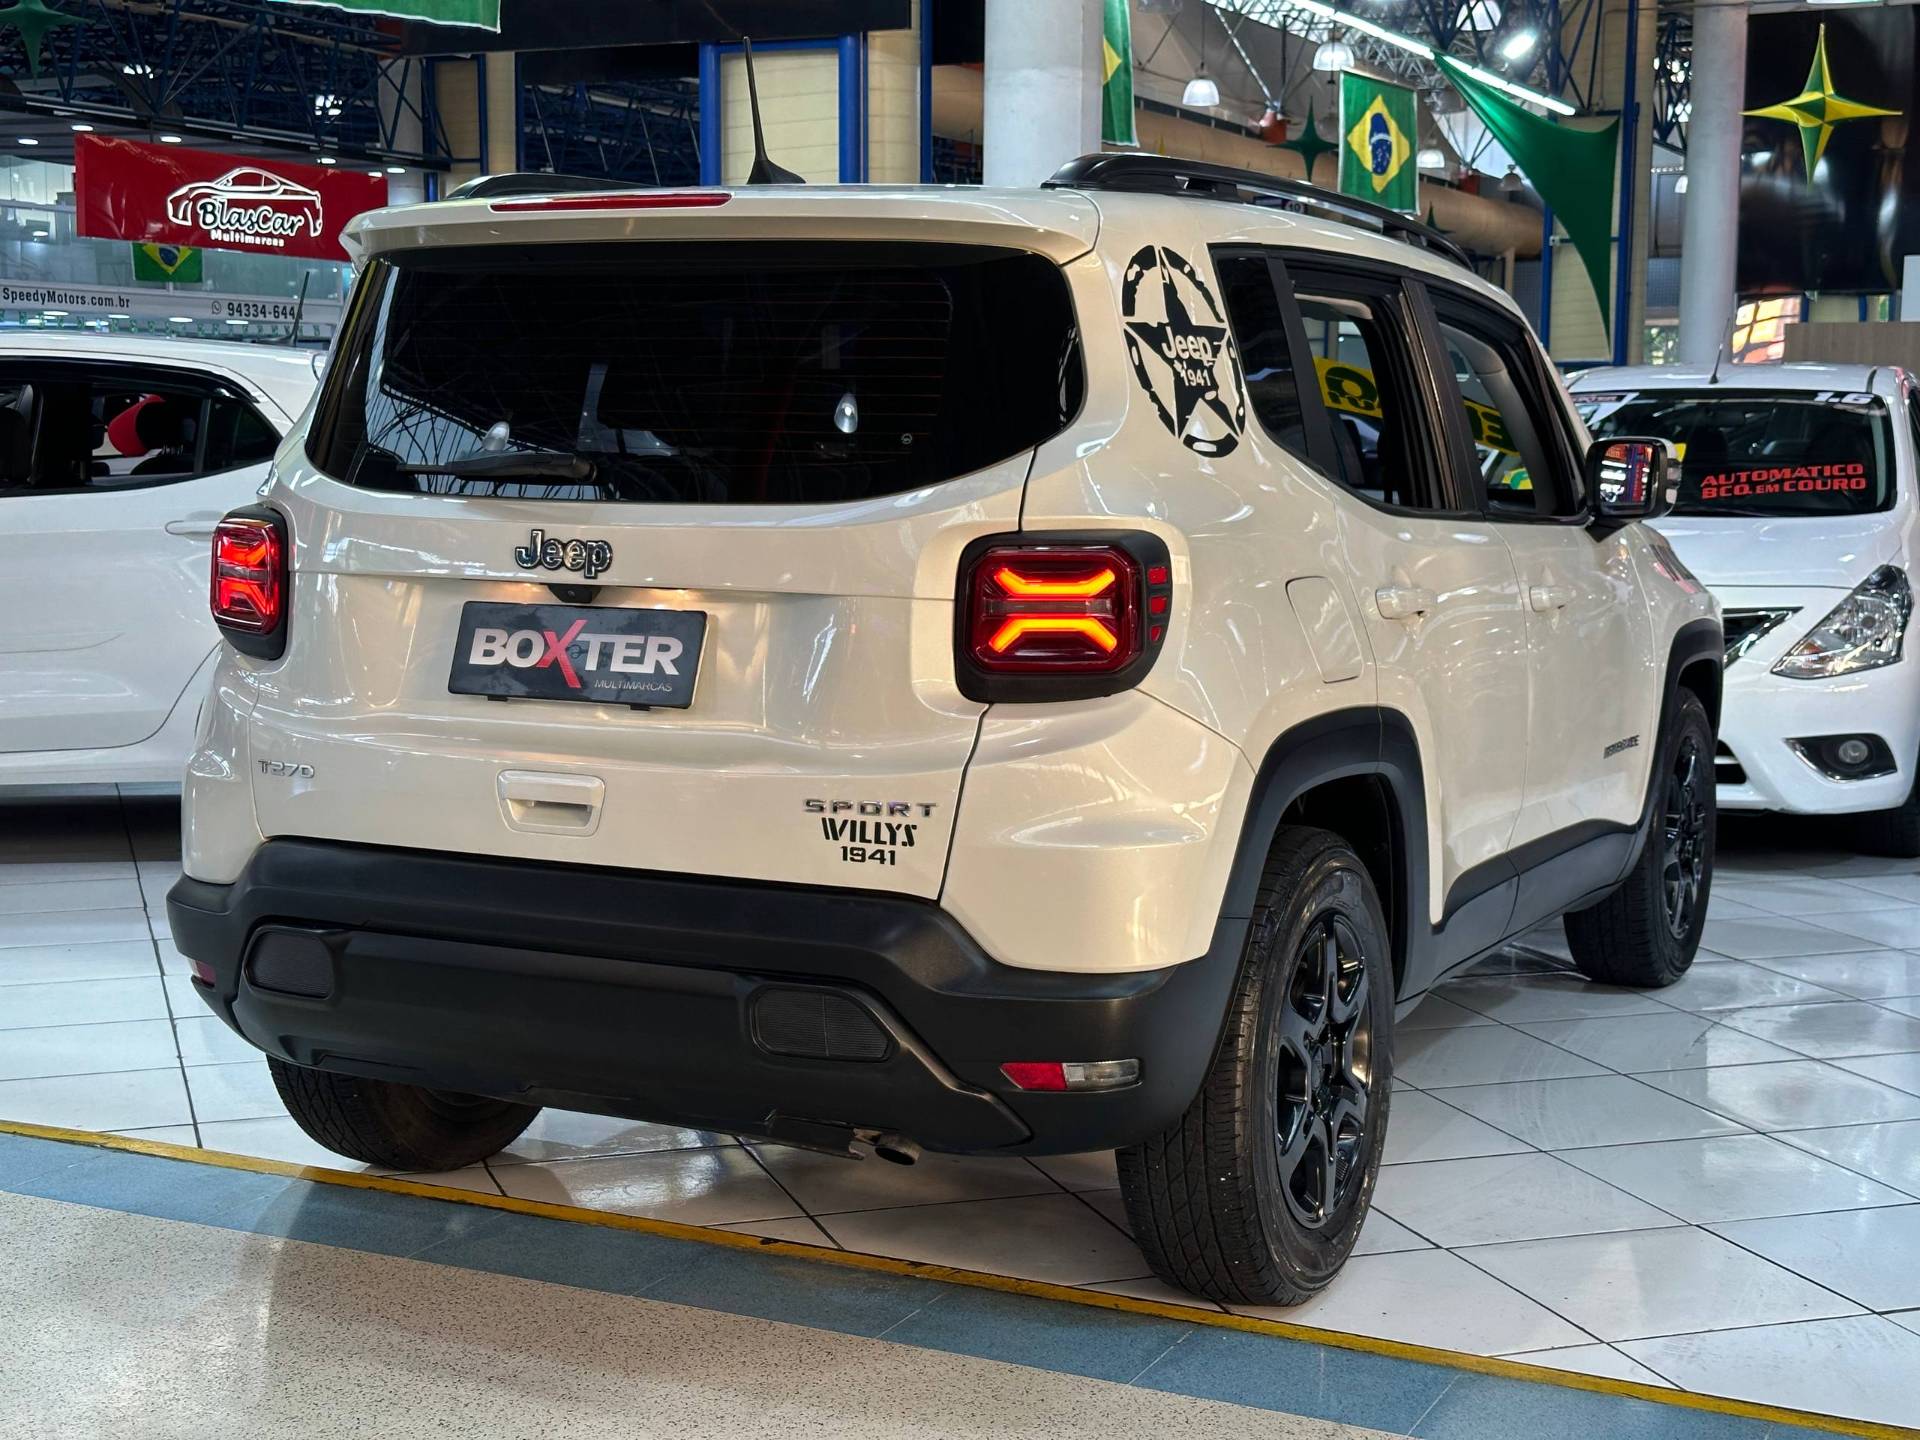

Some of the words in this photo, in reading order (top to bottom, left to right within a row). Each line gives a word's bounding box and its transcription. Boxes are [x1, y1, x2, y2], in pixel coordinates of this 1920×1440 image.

[197, 197, 305, 236] BlasCar
[2, 287, 130, 308] SpeedyMotors.com.br
[1161, 325, 1213, 367] Jeep
[1180, 368, 1211, 387] 1941
[1700, 463, 1865, 488] AUTOMATICO
[1755, 483, 1780, 495] EM
[1783, 477, 1867, 493] COURO
[514, 529, 613, 580] Jeep
[468, 619, 685, 689] BOXTER
[594, 679, 673, 693] MULTIMARCAS
[804, 799, 937, 817] SPORT
[821, 817, 917, 847] WILLYS
[840, 846, 896, 866] 1941
